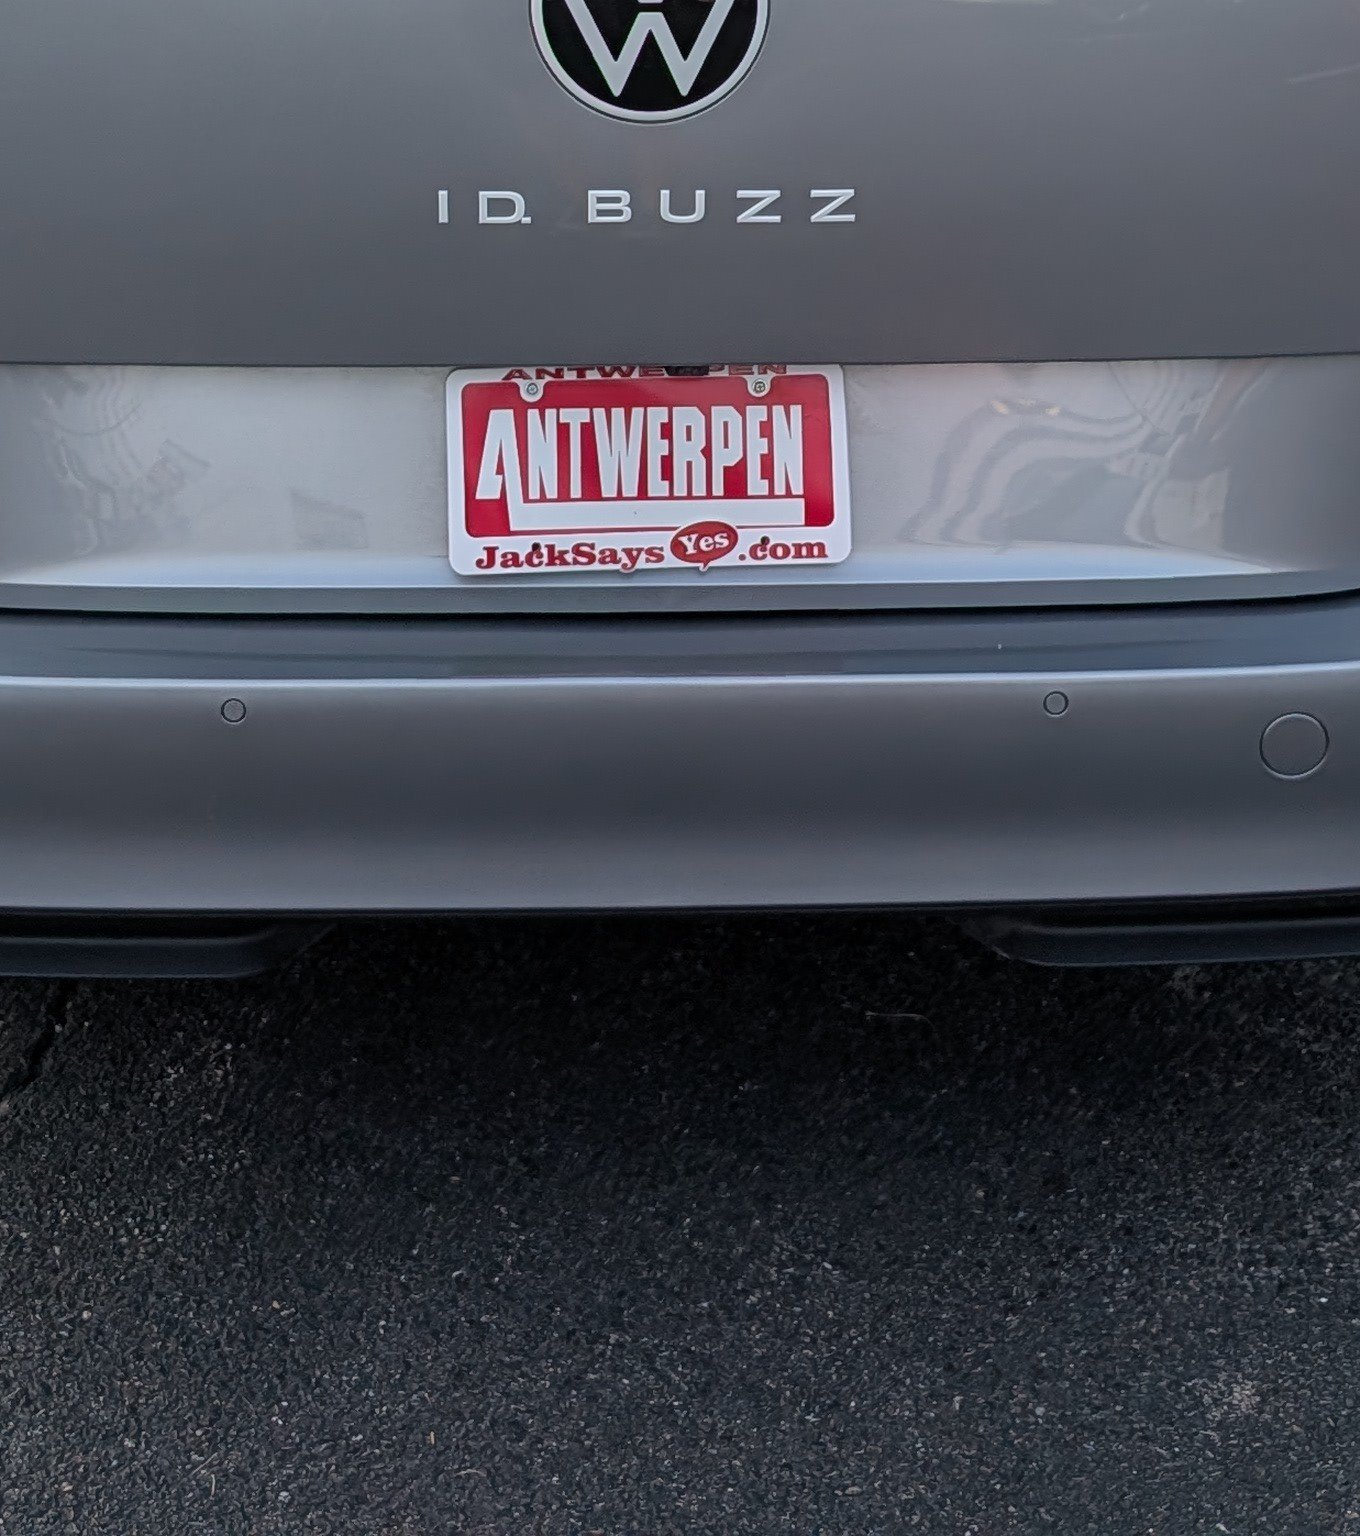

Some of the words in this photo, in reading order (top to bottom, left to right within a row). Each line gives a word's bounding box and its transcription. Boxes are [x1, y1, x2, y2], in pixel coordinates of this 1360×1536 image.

[587, 188, 856, 224] BUZZ
[501, 363, 787, 381] ANTWEPEN
[475, 404, 805, 506] ANTWERPEN
